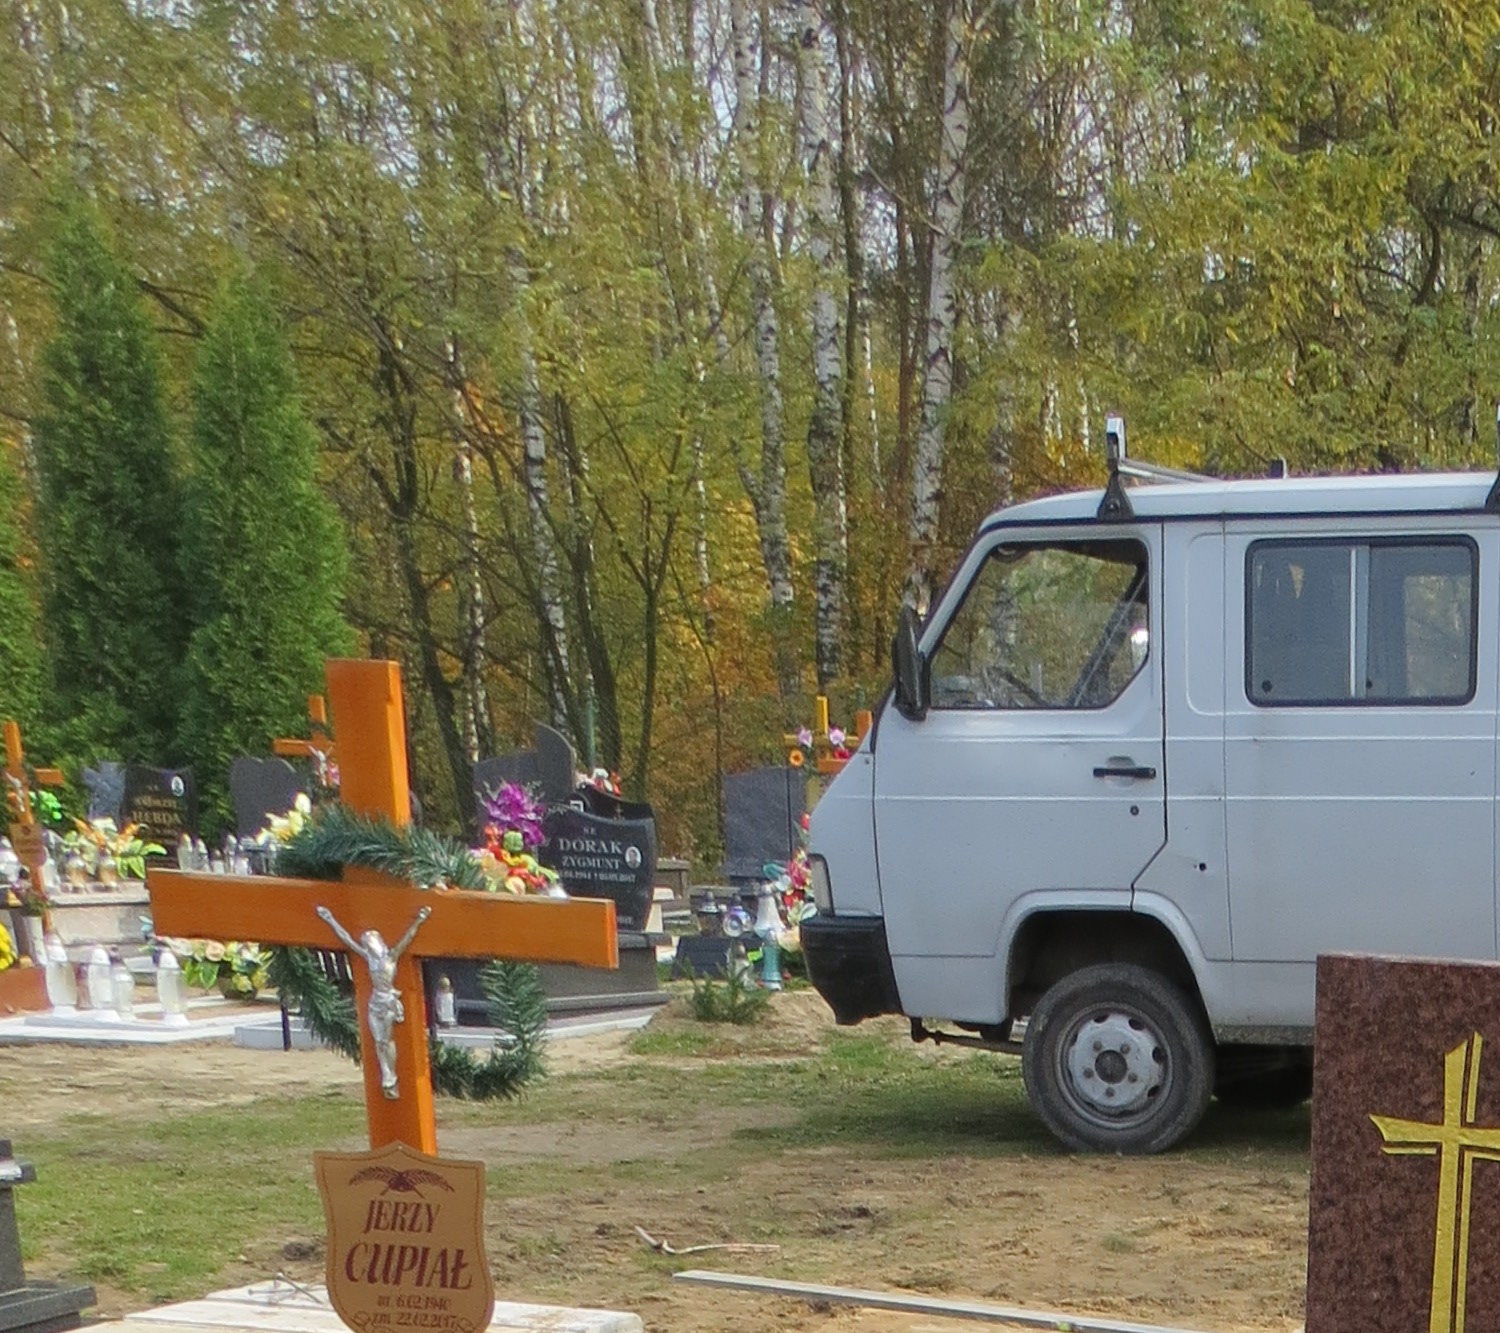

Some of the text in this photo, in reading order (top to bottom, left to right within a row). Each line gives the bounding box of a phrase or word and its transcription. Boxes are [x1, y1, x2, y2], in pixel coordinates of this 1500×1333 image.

[558, 838, 622, 854] DORAK
[562, 855, 620, 869] ZYGMUNT
[361, 1199, 441, 1234] JERZY
[345, 1241, 472, 1290] CUPIAŁ
